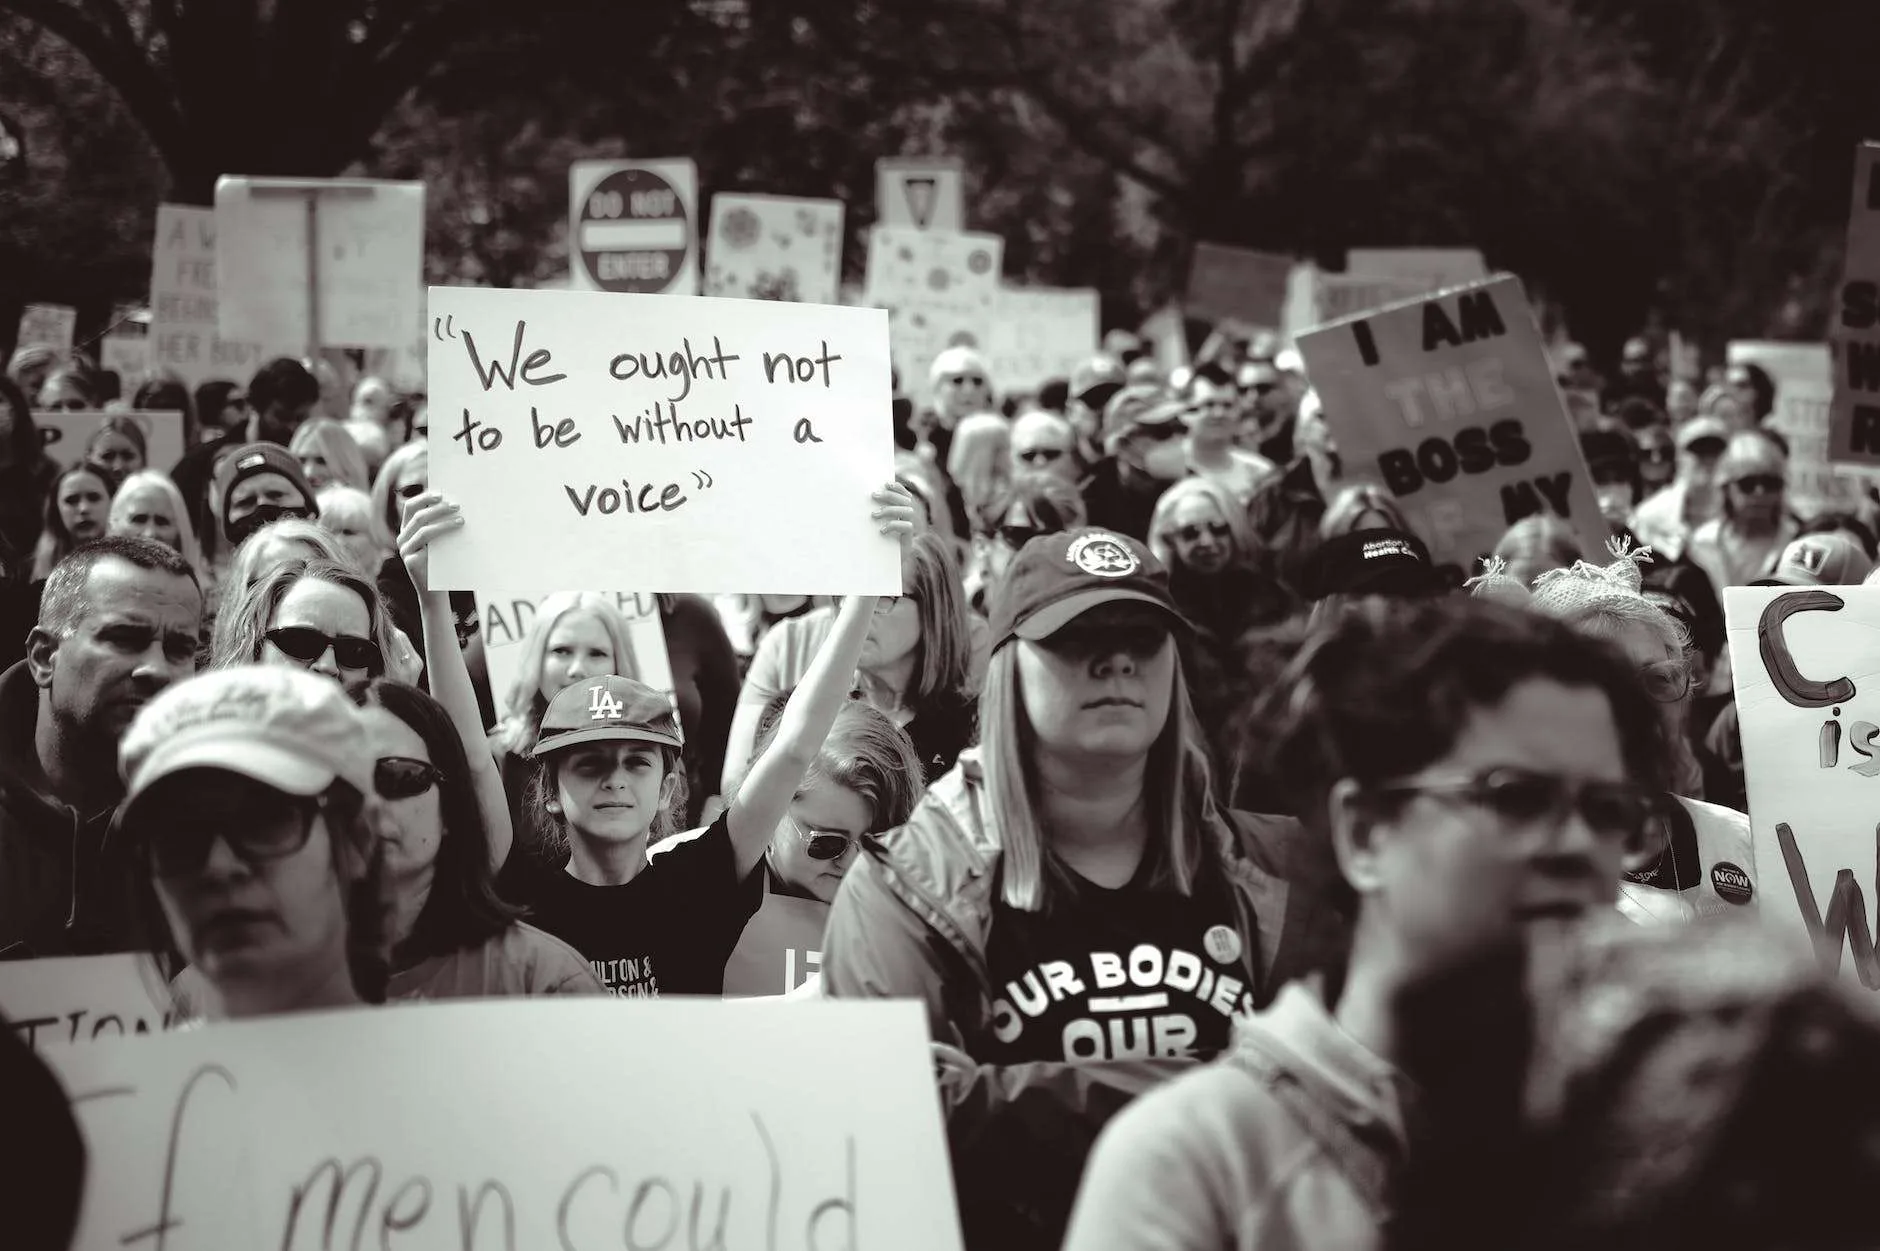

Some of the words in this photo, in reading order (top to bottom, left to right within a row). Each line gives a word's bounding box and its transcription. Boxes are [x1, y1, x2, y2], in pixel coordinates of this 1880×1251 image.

[589, 189, 623, 219] DO
[630, 188, 674, 218] NOT
[597, 251, 669, 281] ENTER
[1352, 319, 1380, 367] I
[1422, 290, 1507, 352] AM
[609, 336, 740, 402] ought
[763, 340, 842, 388] not
[1384, 357, 1517, 430] THE
[452, 407, 503, 455] to
[530, 406, 582, 449] be
[612, 401, 753, 445] without
[793, 417, 824, 444] a
[1377, 419, 1532, 497] BOSS
[564, 469, 713, 516] voice"
[1500, 471, 1572, 527] MY
[1362, 540, 1403, 552] Abortion
[1363, 546, 1399, 560] Health
[588, 683, 623, 721] LA
[1818, 706, 1880, 778] is
[1713, 869, 1749, 888] NOW
[643, 956, 651, 978] &
[993, 960, 1086, 1044] OUR
[1061, 1012, 1201, 1061] OUR
[281, 1155, 516, 1251] men
[556, 1107, 860, 1251] could
